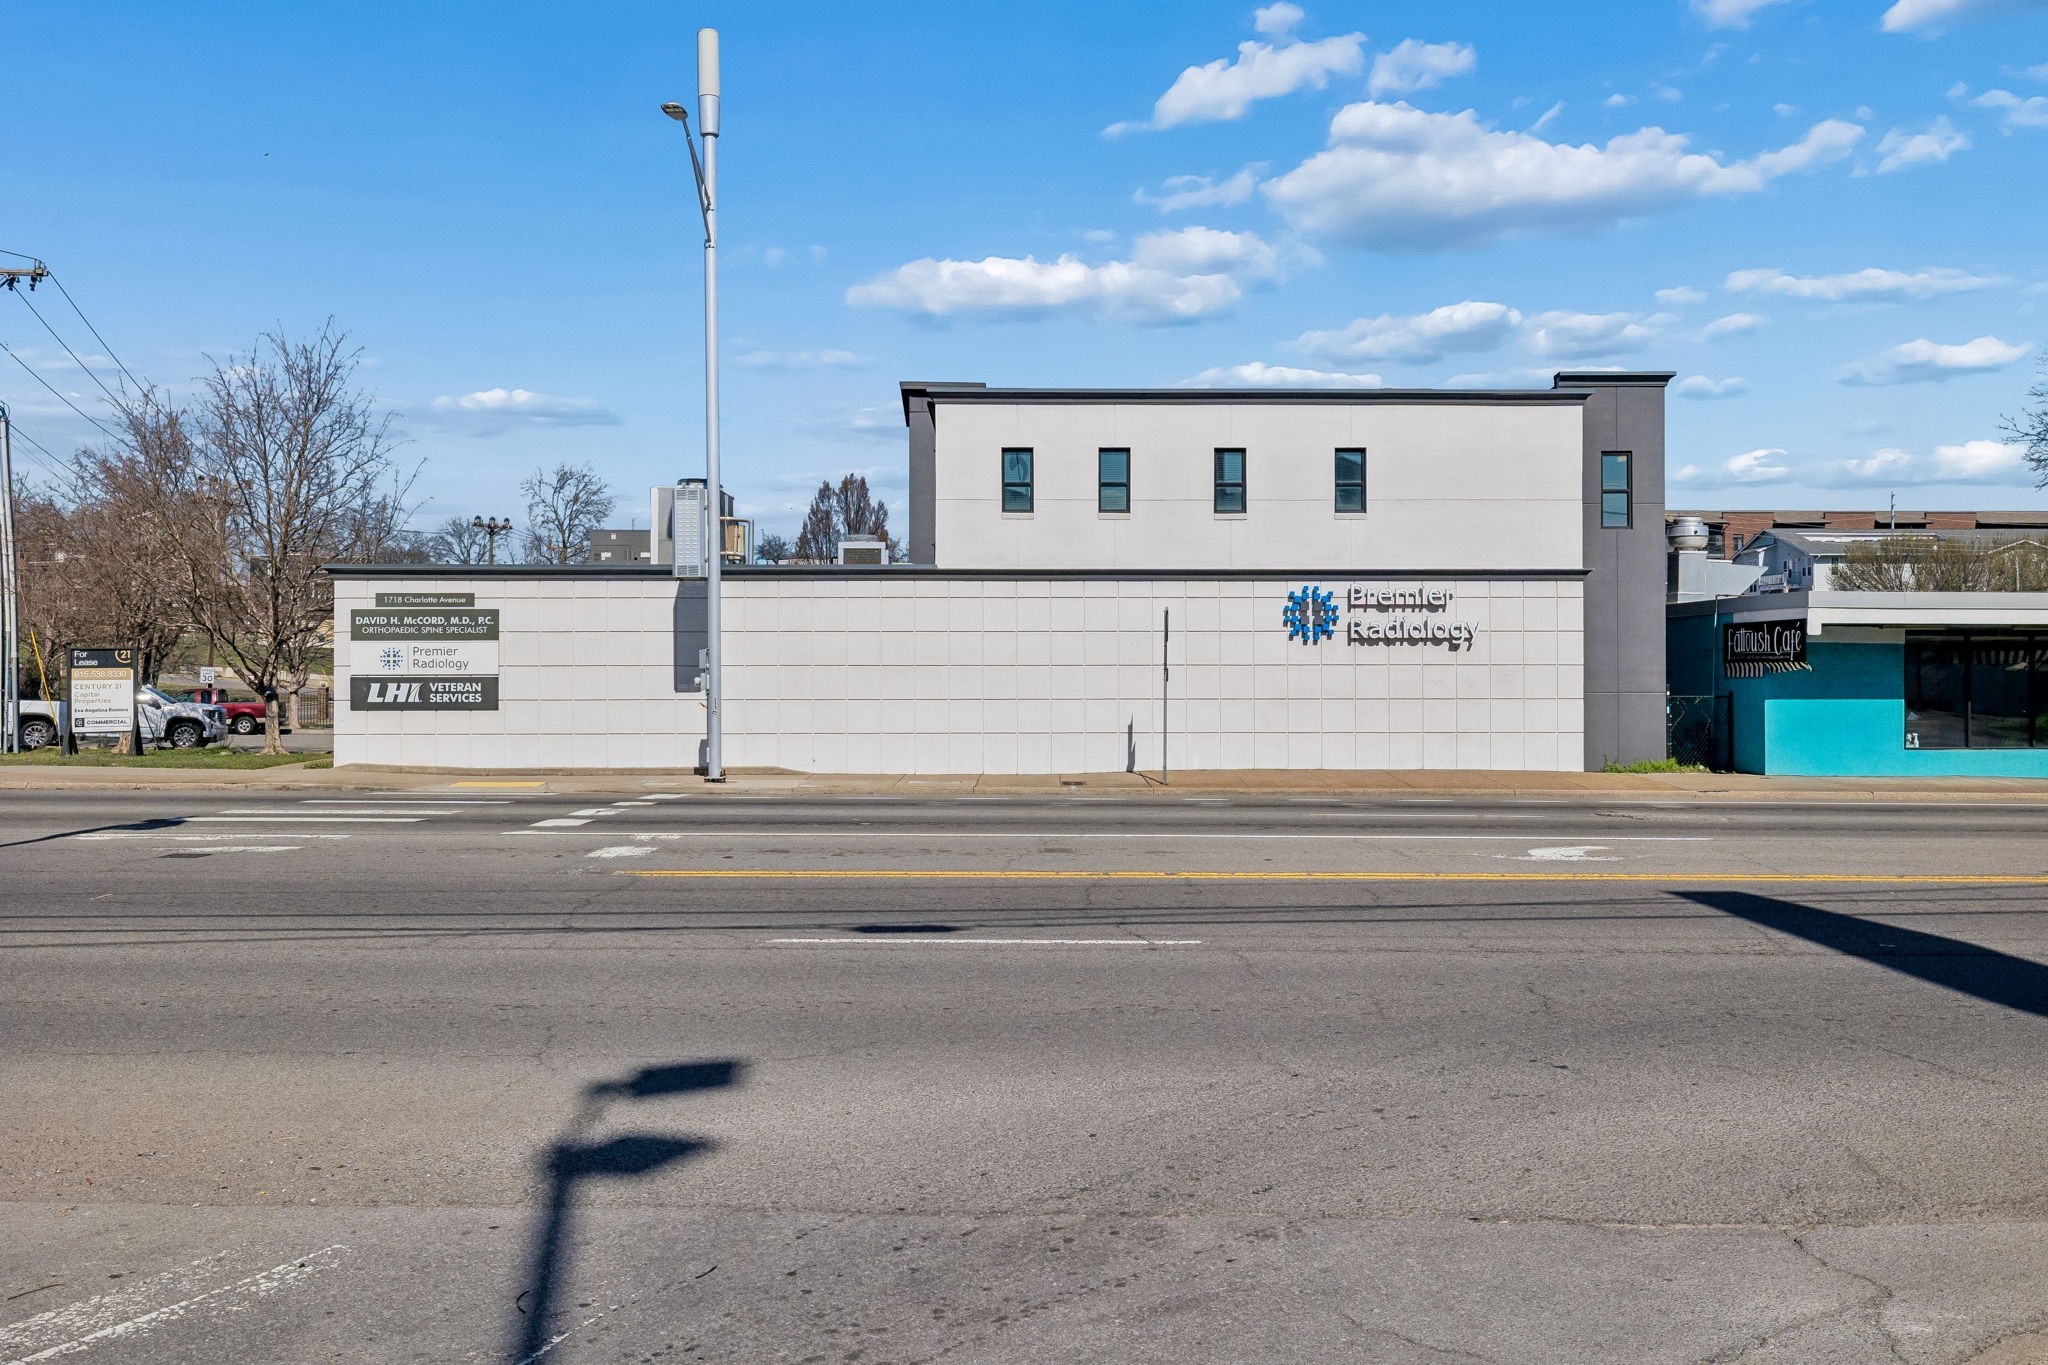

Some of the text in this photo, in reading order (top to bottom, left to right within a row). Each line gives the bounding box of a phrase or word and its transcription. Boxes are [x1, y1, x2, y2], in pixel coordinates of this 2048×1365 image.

[1350, 583, 1455, 605] Premier
[356, 616, 494, 626] DAVID H. McCORD, M.D., P.C.
[362, 626, 488, 634] ORTHOPAEDIC SPINE SPECIALIST
[1350, 616, 1480, 644] Radiology
[1774, 621, 1802, 661] Café
[74, 650, 88, 658] For
[412, 646, 459, 656] Premier
[412, 658, 470, 671] Radiology
[429, 682, 482, 692] VETERAN
[429, 693, 482, 703] SERVICES
